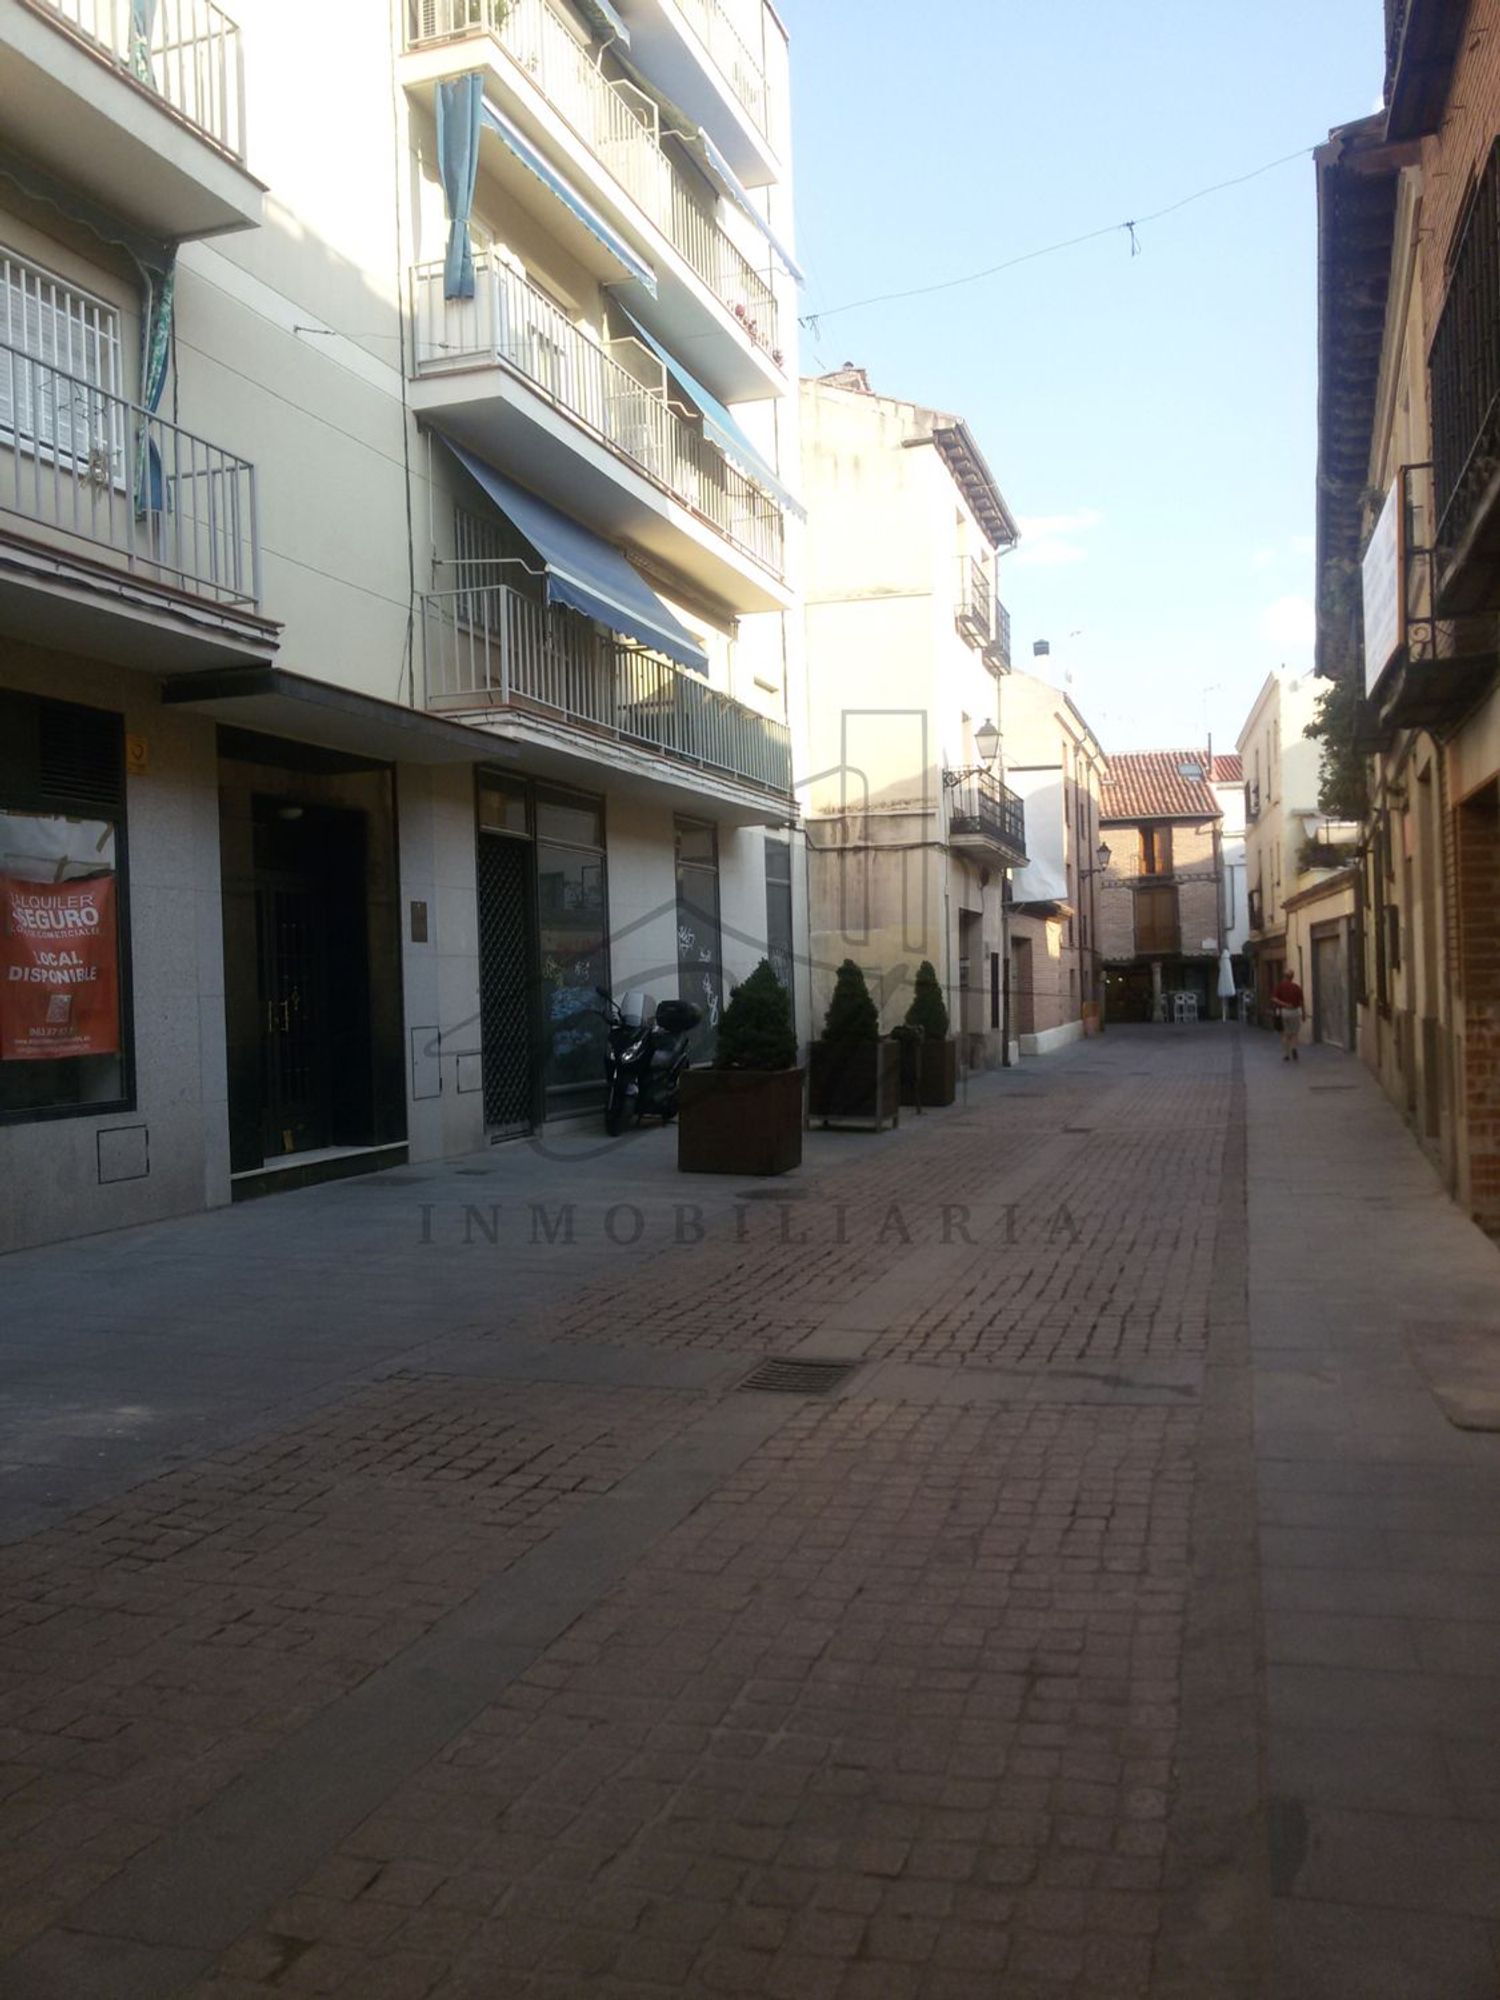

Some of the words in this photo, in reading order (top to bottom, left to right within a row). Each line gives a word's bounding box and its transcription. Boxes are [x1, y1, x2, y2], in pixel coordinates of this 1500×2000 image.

[10, 893, 94, 909] ALQUILER
[12, 907, 99, 929] SEGURO
[32, 950, 83, 967] LOCAL
[8, 966, 97, 984] DISPONIBLE
